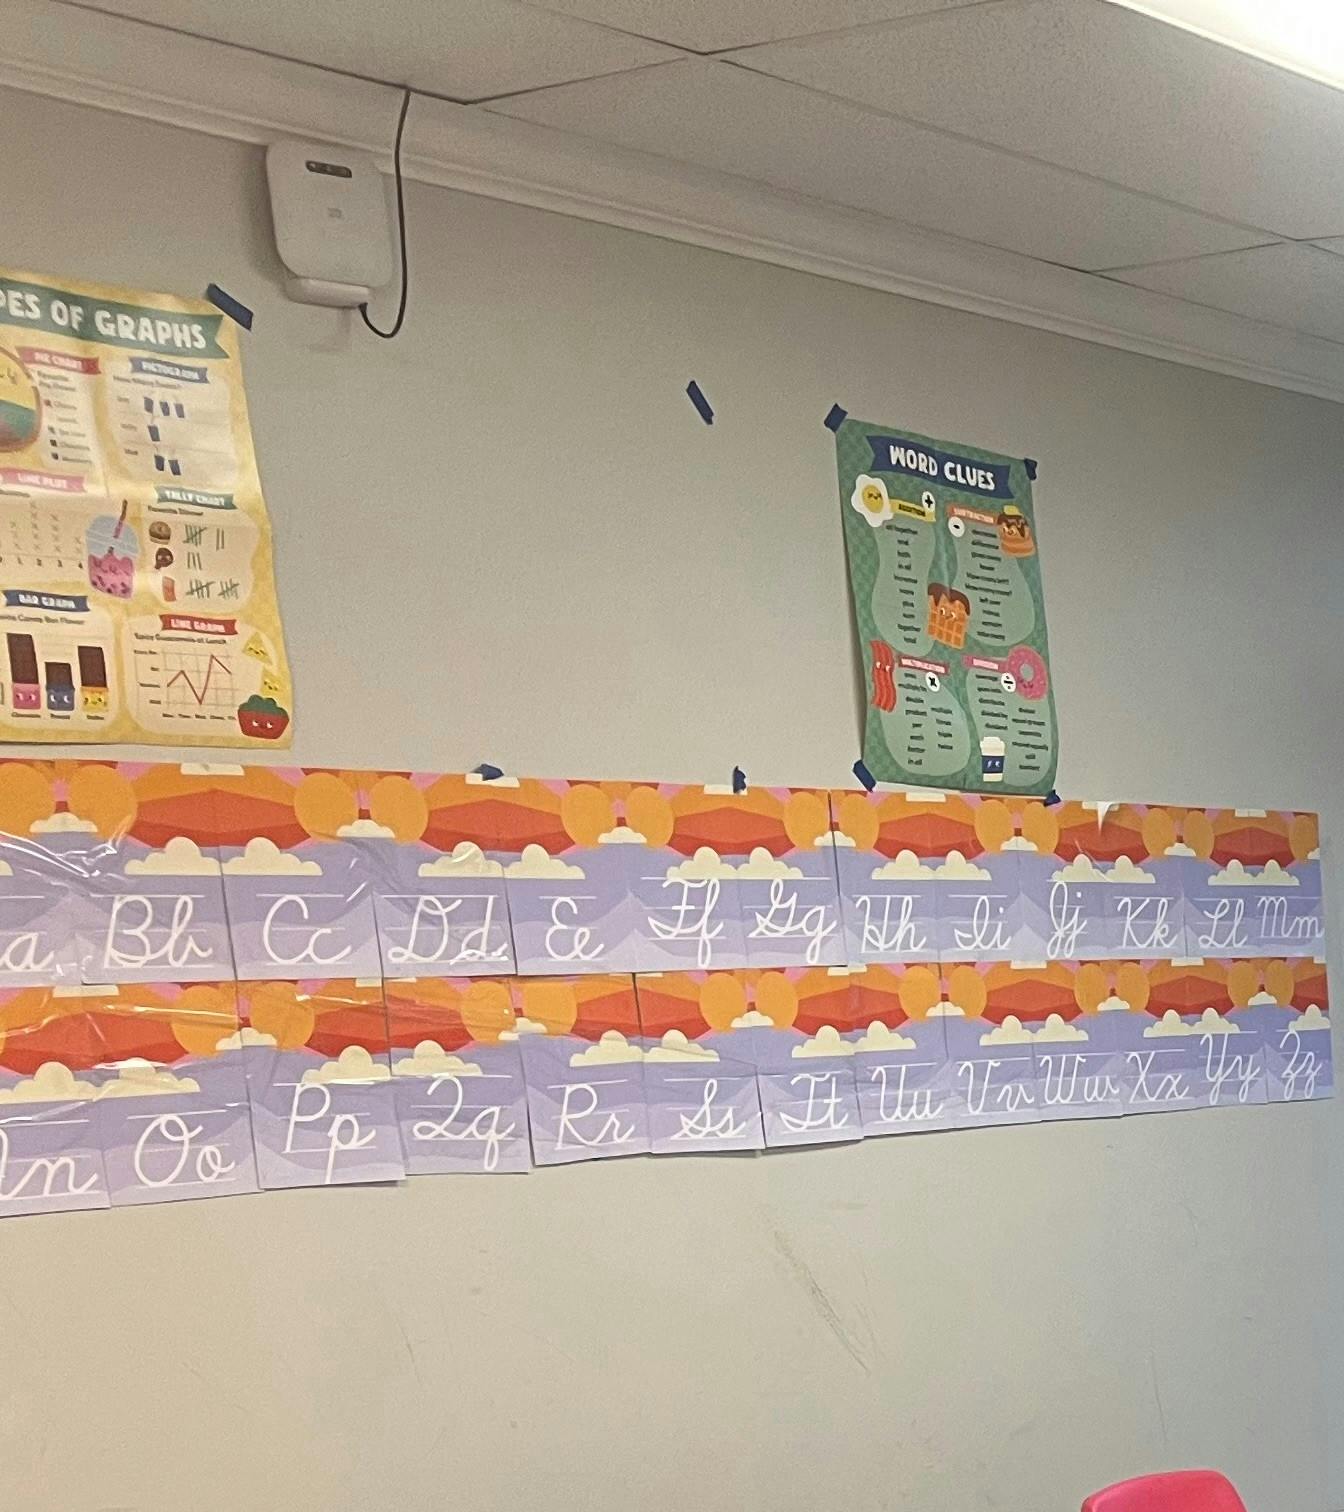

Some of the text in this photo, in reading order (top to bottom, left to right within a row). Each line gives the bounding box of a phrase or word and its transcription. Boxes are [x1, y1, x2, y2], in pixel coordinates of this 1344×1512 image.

[51, 300, 84, 331] OF
[95, 310, 207, 350] GRAPHS
[889, 444, 996, 491] WORD CLUES
